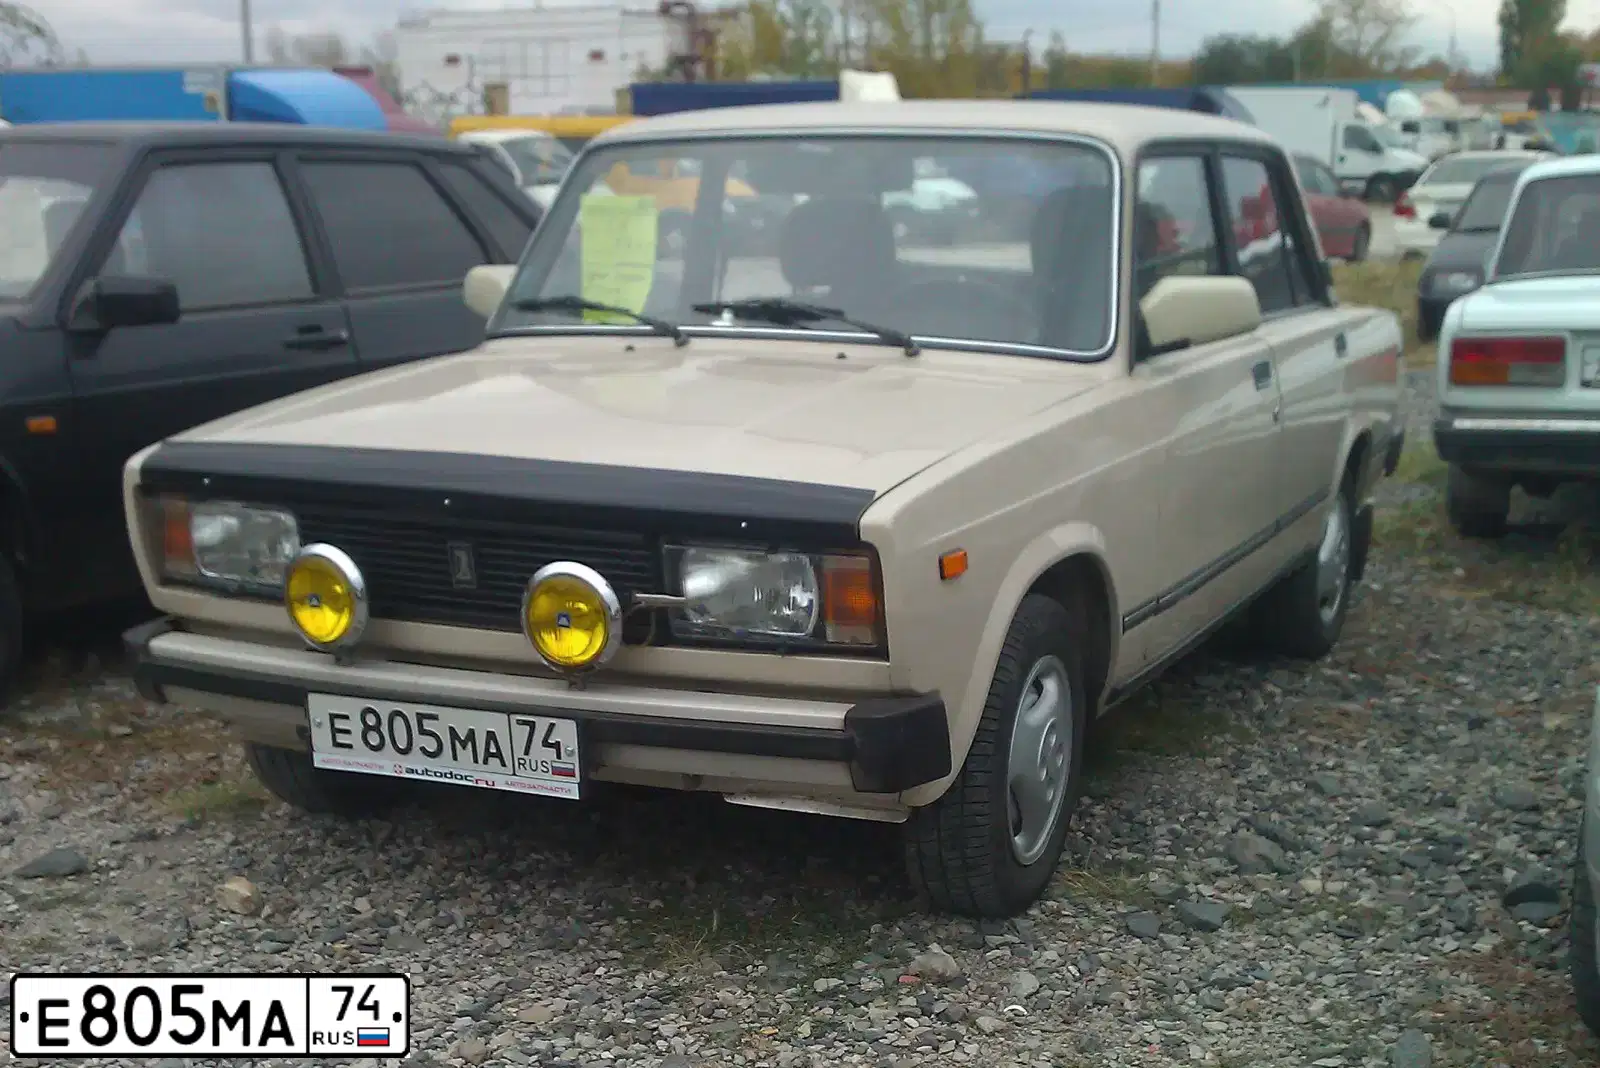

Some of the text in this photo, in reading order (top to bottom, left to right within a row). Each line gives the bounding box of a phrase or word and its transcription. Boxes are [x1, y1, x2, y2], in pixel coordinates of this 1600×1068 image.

[328, 706, 562, 767] E805MA 74
[517, 757, 549, 772] RUS
